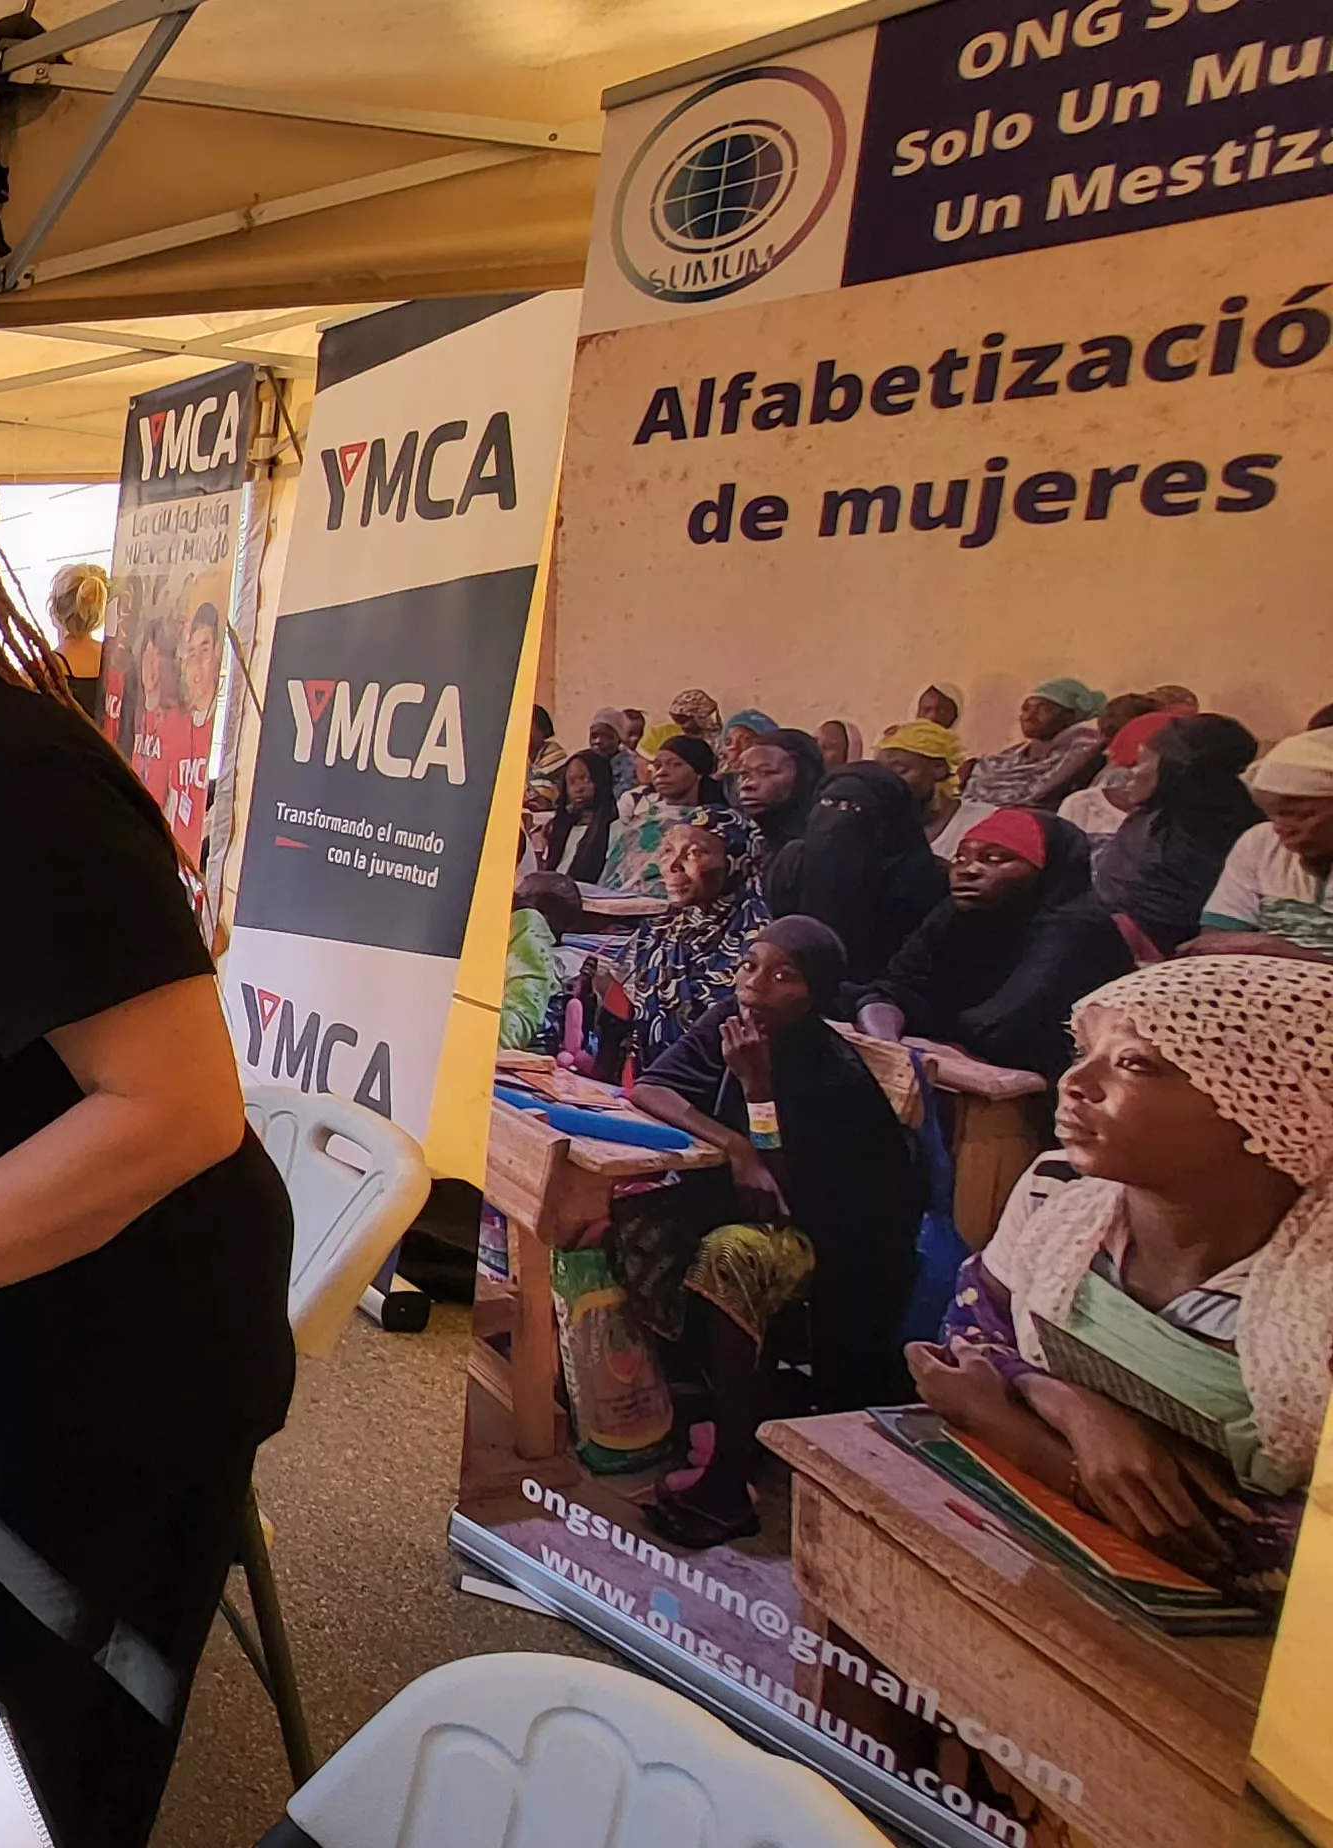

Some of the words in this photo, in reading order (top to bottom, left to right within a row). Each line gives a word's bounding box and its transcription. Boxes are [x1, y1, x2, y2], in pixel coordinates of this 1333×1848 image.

[958, 0, 1123, 80] ONG
[892, 109, 1034, 177] Solo
[1057, 80, 1161, 135] Un
[1187, 36, 1333, 106] Mu
[933, 192, 1023, 242] Un
[648, 243, 774, 293] SUMUM
[633, 282, 1333, 446] Alfabetizació
[139, 391, 239, 482] YMCA
[321, 411, 517, 531] YMCA
[687, 483, 789, 545] de
[818, 454, 1281, 549] mujeres
[287, 679, 467, 786] YMCA
[276, 802, 373, 840] Transformando
[377, 822, 392, 842] el
[394, 831, 445, 855] mundo
[327, 846, 350, 867] con
[353, 848, 367, 870] la
[367, 852, 440, 888] juventud
[241, 982, 392, 1121] YMCA
[521, 1477, 1084, 1804] ongsumum@gmail.com
[539, 1541, 1028, 1847] www.ongsumum.com
